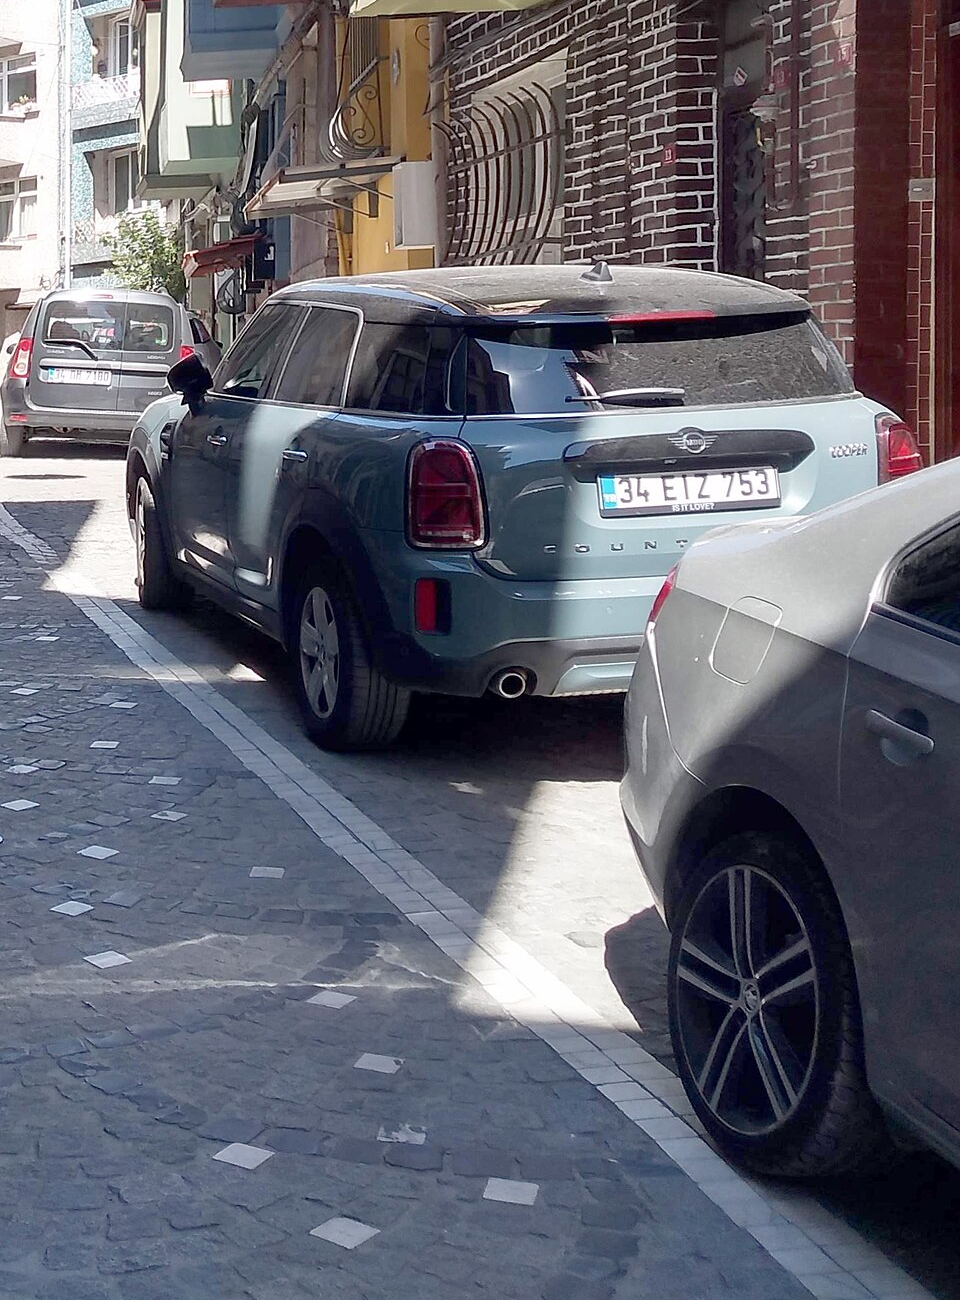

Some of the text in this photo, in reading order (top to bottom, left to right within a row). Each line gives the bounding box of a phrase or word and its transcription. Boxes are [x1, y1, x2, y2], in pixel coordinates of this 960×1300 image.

[829, 443, 868, 458] COOPER
[619, 476, 649, 503] 34
[660, 473, 710, 501] EIZ
[721, 469, 769, 497] 753
[672, 504, 680, 512] IS
[689, 502, 715, 510] LOVE?
